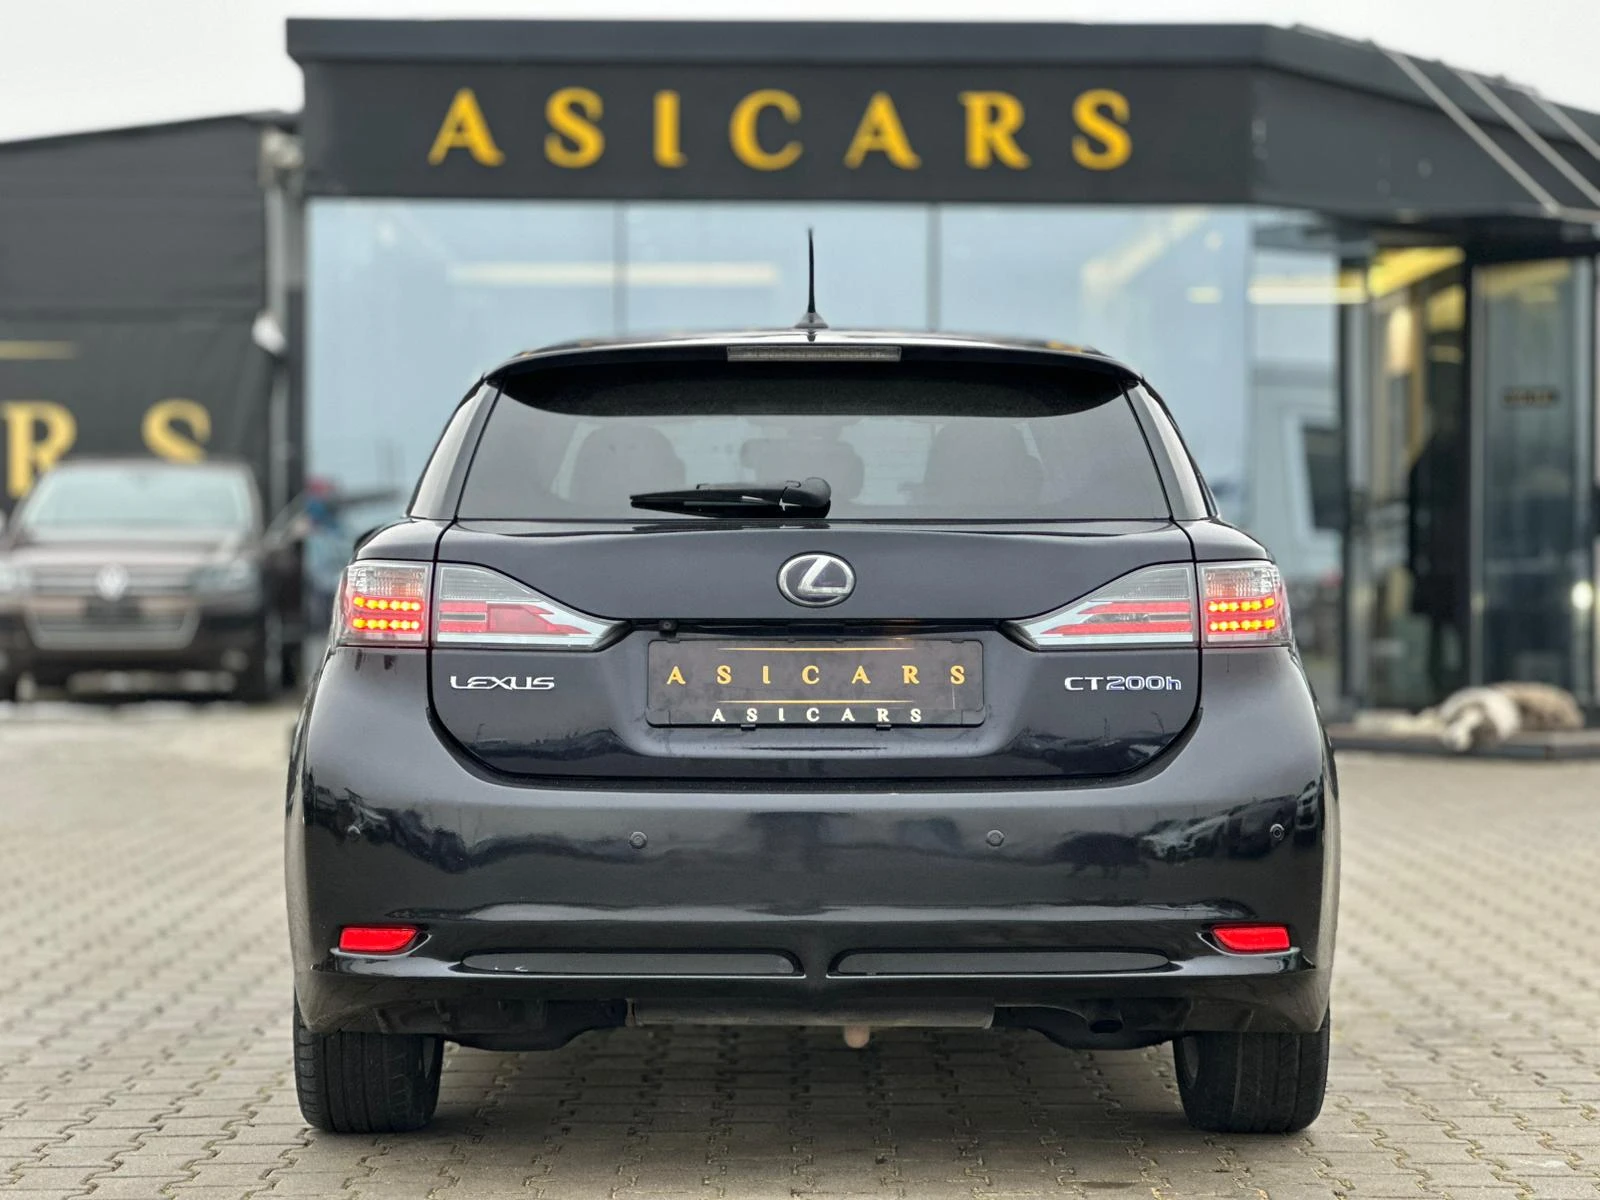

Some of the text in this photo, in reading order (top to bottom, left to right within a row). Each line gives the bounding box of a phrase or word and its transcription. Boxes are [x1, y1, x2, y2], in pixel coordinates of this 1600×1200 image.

[428, 88, 1133, 170] ASICARS
[666, 665, 965, 684] ASICARS
[450, 676, 555, 690] LEXUS
[711, 708, 922, 722] ASICARS
